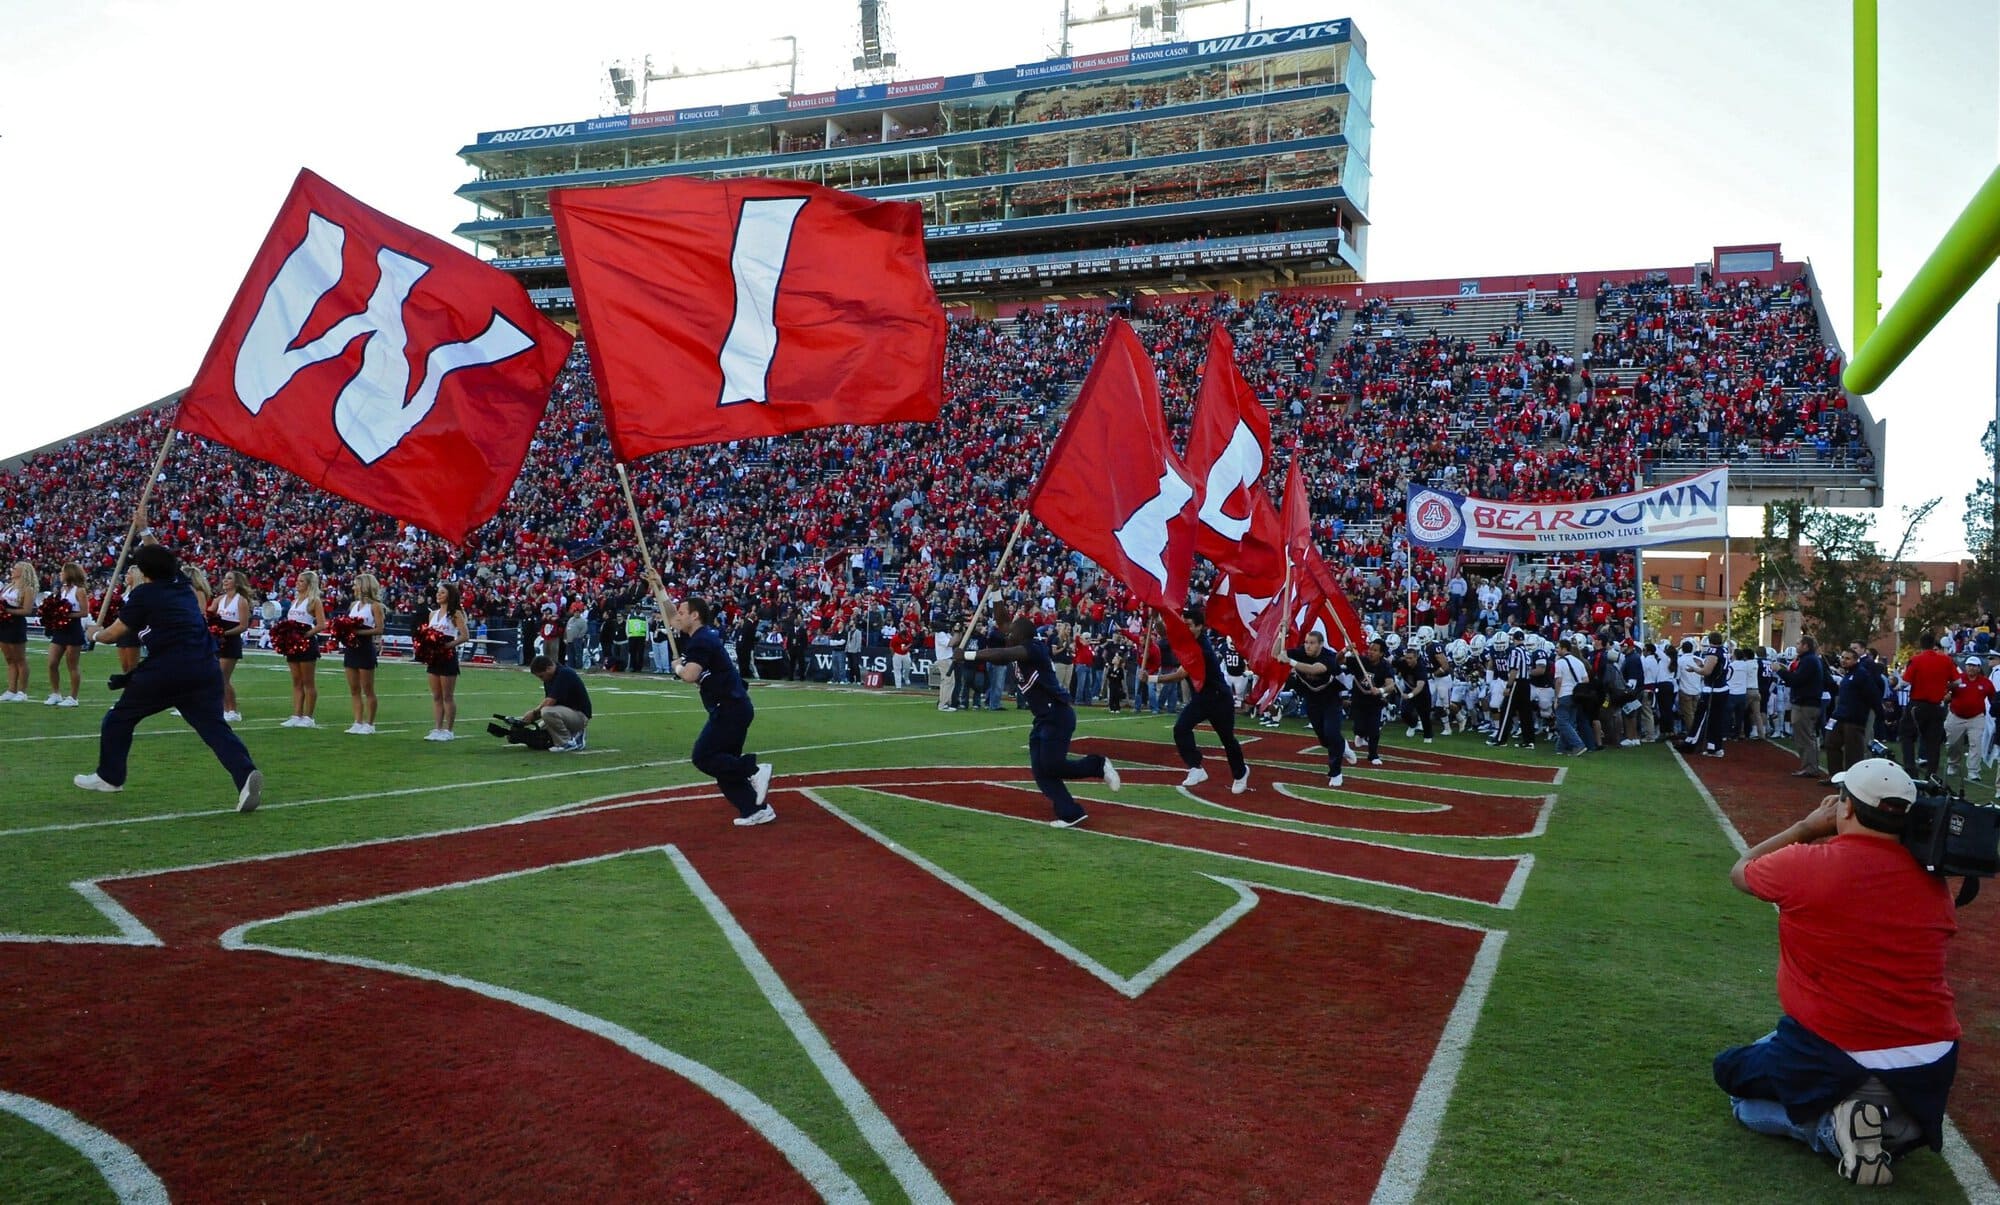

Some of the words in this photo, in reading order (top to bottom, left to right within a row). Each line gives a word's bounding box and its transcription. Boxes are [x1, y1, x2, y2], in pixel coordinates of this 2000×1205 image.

[1197, 22, 1342, 56] WILDCATS
[1136, 50, 1164, 61] ANTOINE
[1165, 47, 1188, 57] CASON
[1079, 59, 1097, 68] CHRIS
[895, 85, 908, 94] ROB
[909, 82, 939, 92] WALDROP
[818, 96, 835, 105] LEWIS
[684, 111, 703, 120] CHUCK
[704, 109, 720, 118] CECIL
[487, 123, 576, 143] ARIZONA
[1303, 240, 1329, 248] WALDROP
[1461, 286, 1477, 296] 24
[234, 210, 537, 467] W
[1538, 534, 1555, 542] THE
[1557, 531, 1616, 543] TRADITION
[1618, 527, 1645, 538] LIVES
[815, 654, 887, 672] WLS
[1226, 654, 1239, 667] 20
[867, 674, 879, 686] 10
